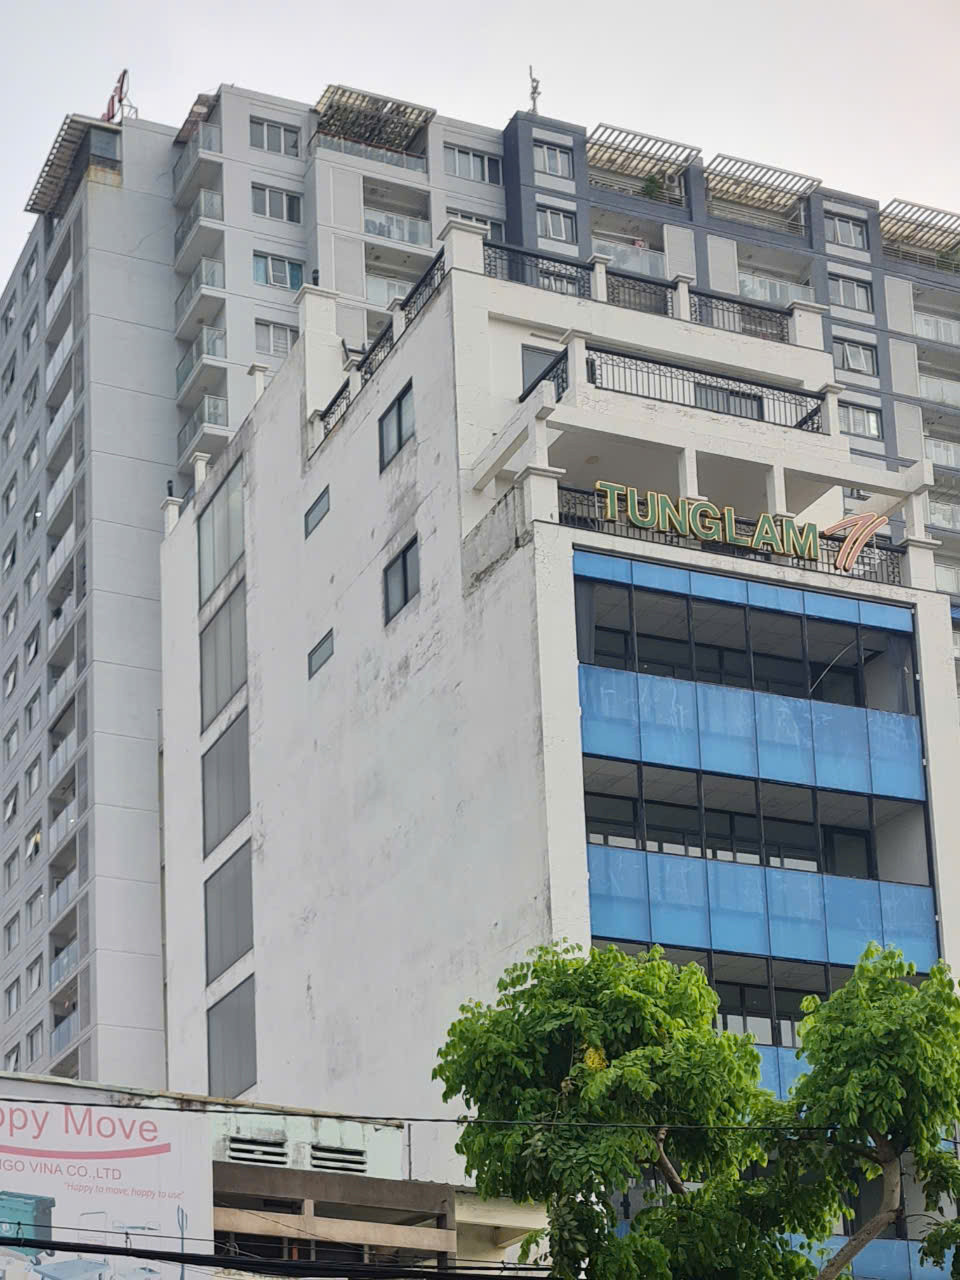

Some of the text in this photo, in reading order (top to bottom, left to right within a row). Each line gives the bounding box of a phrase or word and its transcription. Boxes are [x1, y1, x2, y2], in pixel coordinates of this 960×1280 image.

[595, 480, 819, 561] TUNGLAM
[63, 1104, 159, 1143] Move
[30, 1161, 63, 1176] VINA
[66, 1165, 122, 1180] CO.,LTD
[131, 1188, 156, 1199] happy
